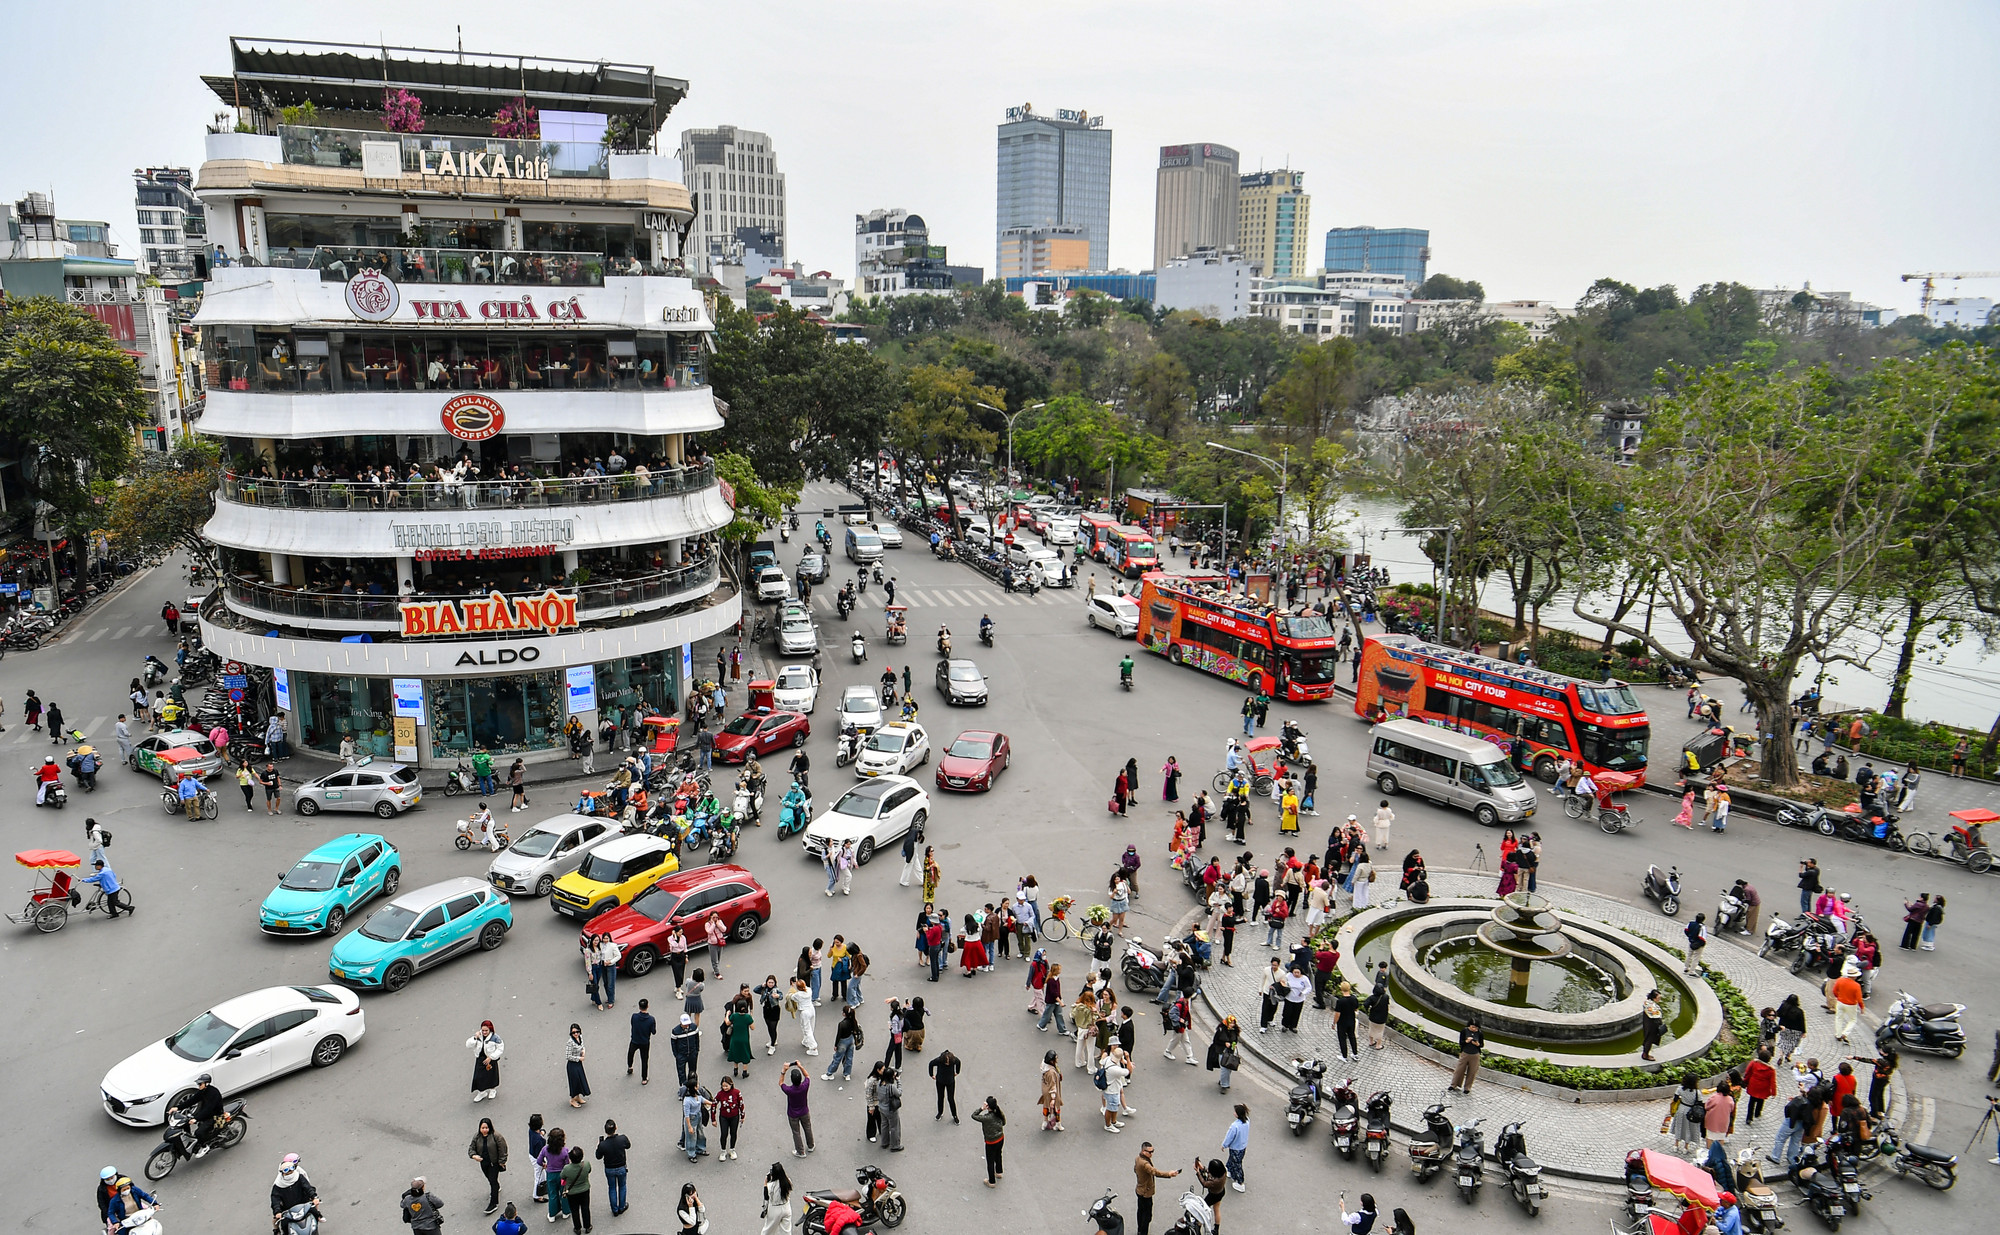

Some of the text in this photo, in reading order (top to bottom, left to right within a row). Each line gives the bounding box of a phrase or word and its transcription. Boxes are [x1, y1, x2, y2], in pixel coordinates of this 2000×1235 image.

[1006, 105, 1024, 119] BIDV
[1059, 108, 1080, 121] BIDV
[419, 149, 550, 180] LAIKA Café
[1161, 157, 1190, 167] GROUP
[643, 211, 677, 232] LAIKA
[409, 294, 587, 320] VUA CHẢ CÁ
[444, 396, 502, 418] HIGHLANDS
[452, 426, 497, 440] COFFEE
[393, 519, 575, 548] HANOI 1930 BISTRO
[415, 544, 557, 562] COFFEE & RESTAURANT
[402, 591, 578, 636] BIA HÀ NỘI
[1207, 613, 1220, 623] CITY
[1220, 617, 1236, 628] TOUR
[455, 646, 541, 667] ALDO
[568, 670, 592, 678] mobifone
[1435, 673, 1448, 683] HA
[1448, 676, 1463, 687] NOI
[1464, 681, 1484, 692] CITY
[1484, 685, 1507, 699] TOUR
